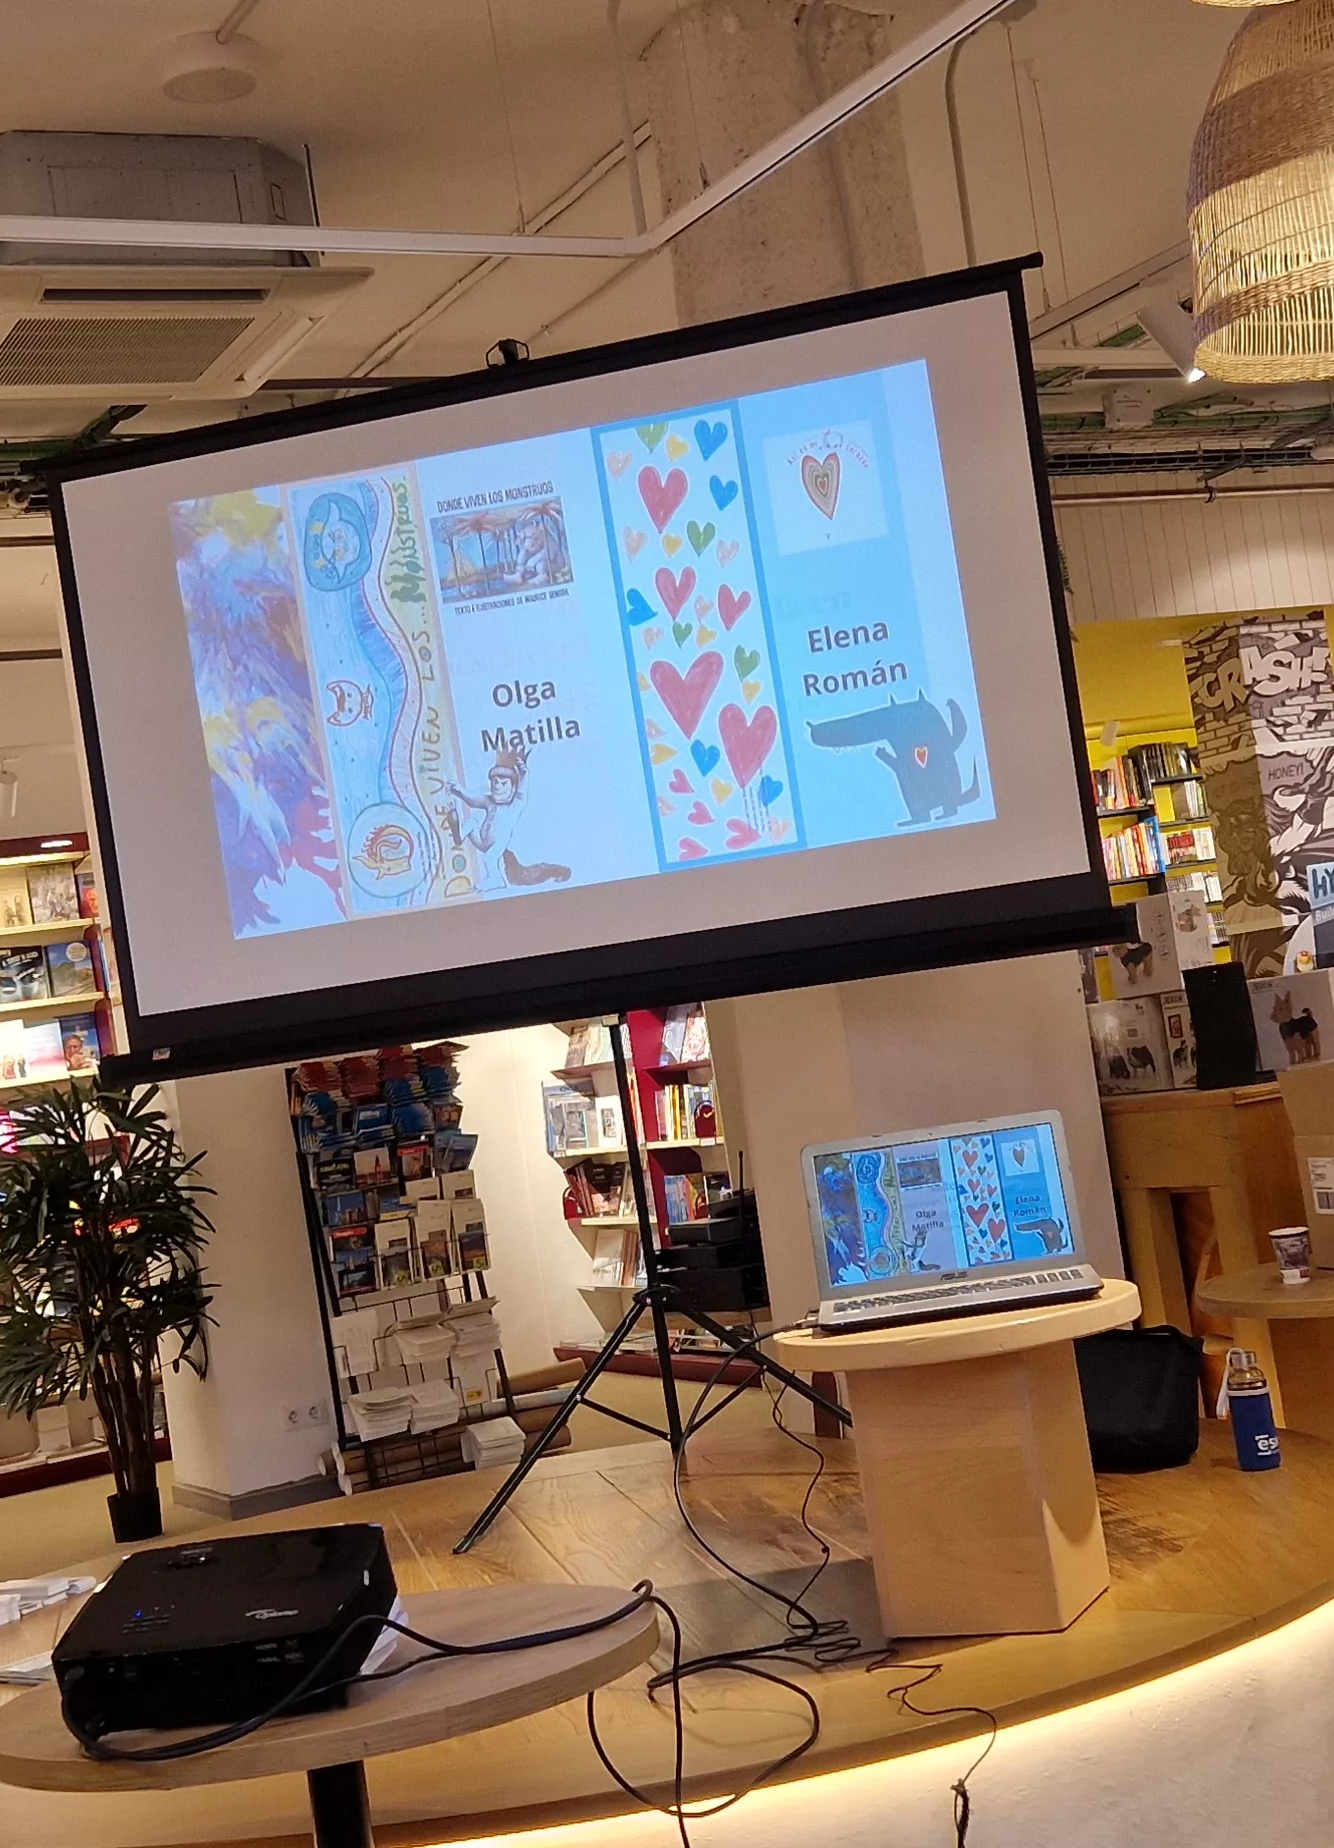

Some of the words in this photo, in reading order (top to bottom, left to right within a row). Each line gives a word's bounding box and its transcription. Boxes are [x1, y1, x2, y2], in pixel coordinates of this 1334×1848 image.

[436, 497, 464, 513] DONDE
[465, 494, 487, 509] VIVEN
[488, 490, 504, 504] LOS
[505, 481, 554, 500] MONSTRUOS
[808, 622, 889, 653] Elena
[803, 660, 908, 697] Román
[1191, 645, 1330, 713] CRASH!
[492, 680, 556, 709] Olga
[481, 716, 580, 752] Matilla
[1268, 762, 1304, 780] HONEY!
[915, 1209, 937, 1219] Olga
[1013, 1206, 1047, 1218] Román
[1015, 1194, 1041, 1205] Elena
[940, 1271, 968, 1281] ASUS
